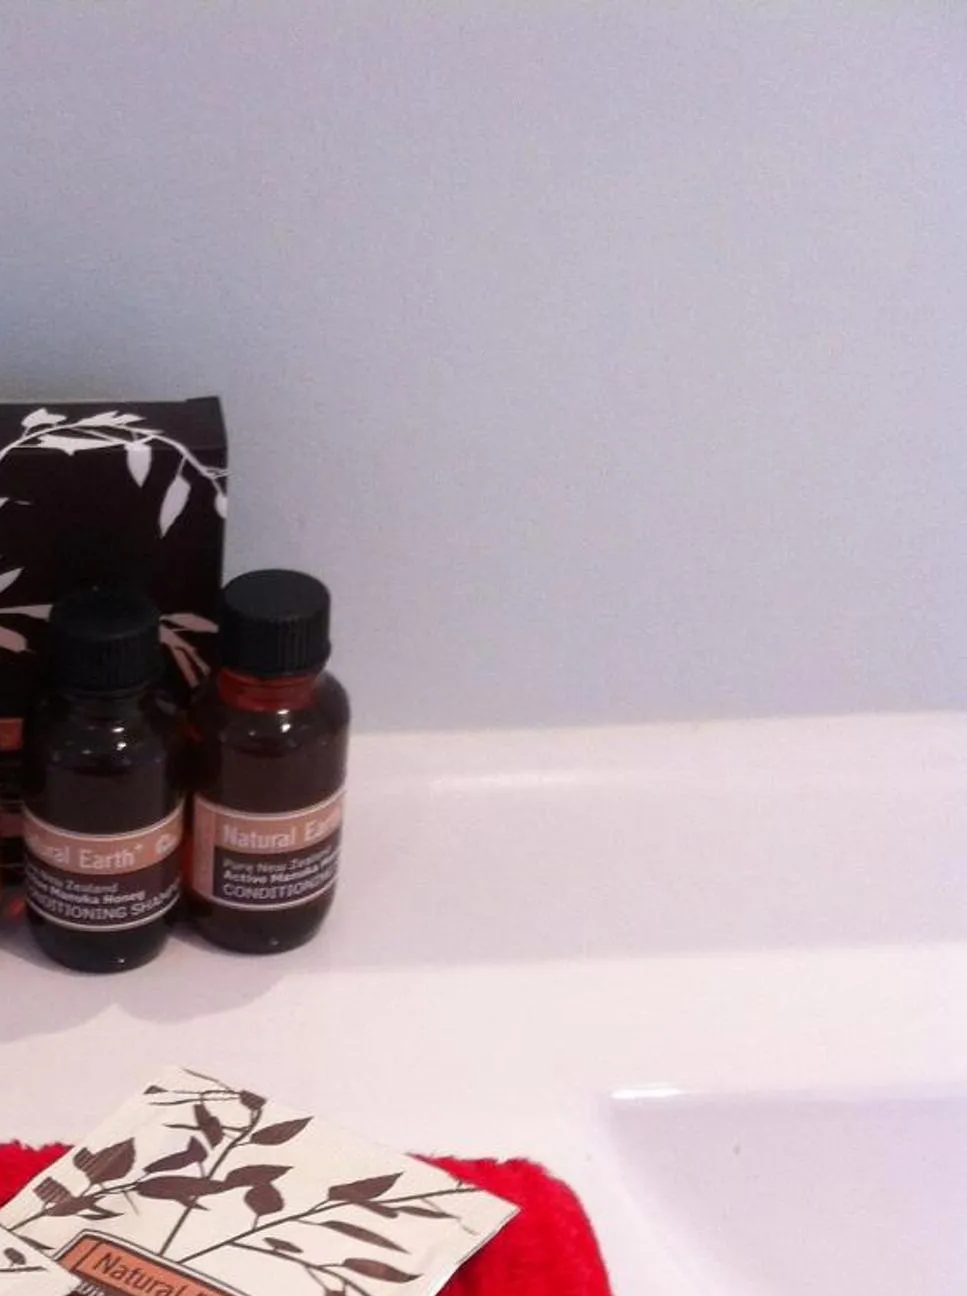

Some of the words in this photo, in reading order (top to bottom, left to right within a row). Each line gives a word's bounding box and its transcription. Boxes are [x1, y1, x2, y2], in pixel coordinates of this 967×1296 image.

[222, 824, 296, 849] Natural
[79, 848, 135, 870] Earth
[223, 870, 267, 884] Active
[103, 890, 146, 904] Honey
